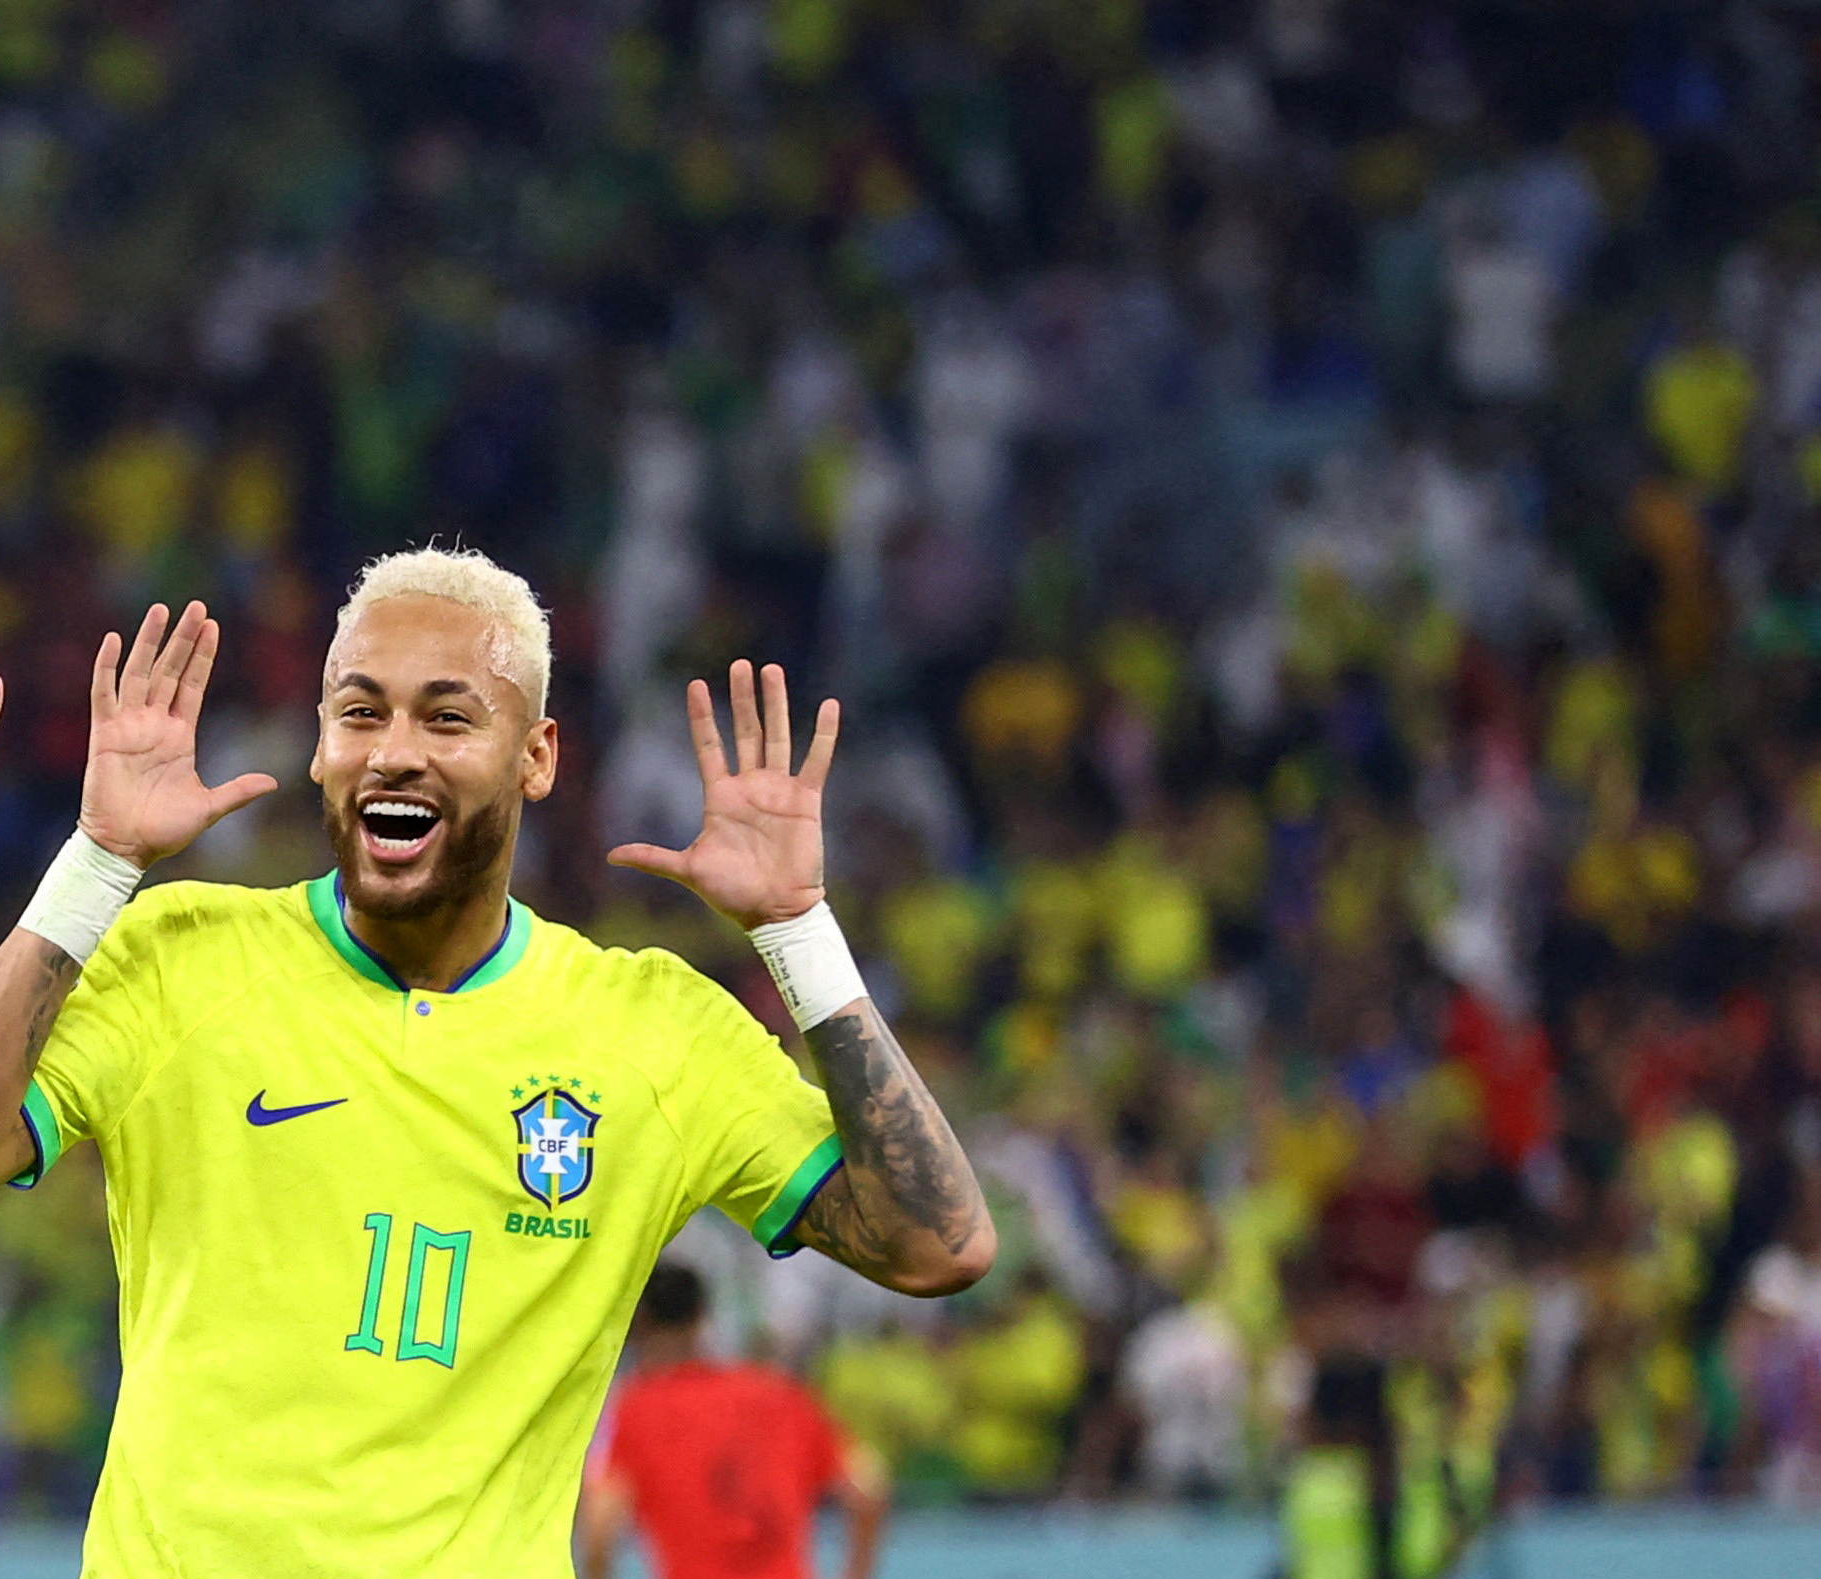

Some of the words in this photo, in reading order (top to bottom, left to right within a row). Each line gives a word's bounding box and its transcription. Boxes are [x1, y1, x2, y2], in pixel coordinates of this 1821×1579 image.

[538, 1139, 569, 1153] CBF
[504, 1211, 592, 1239] BRASIL
[343, 1212, 472, 1370] 10
